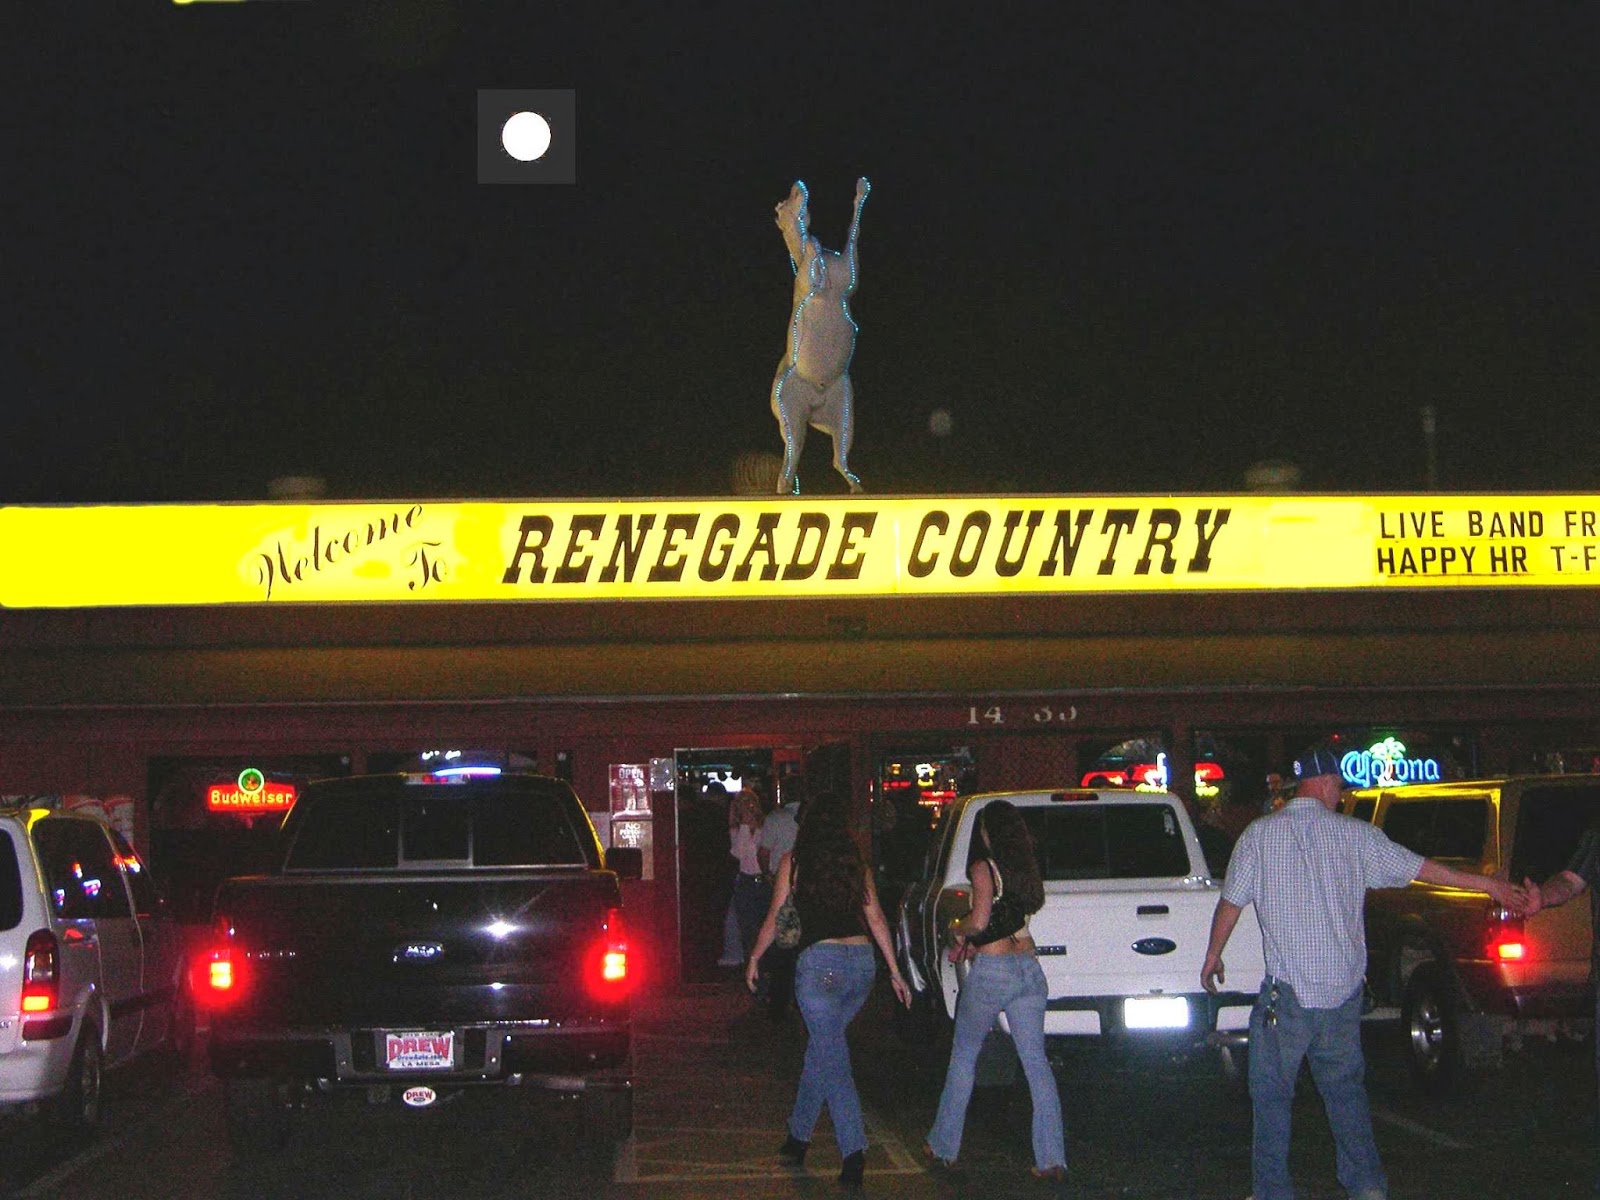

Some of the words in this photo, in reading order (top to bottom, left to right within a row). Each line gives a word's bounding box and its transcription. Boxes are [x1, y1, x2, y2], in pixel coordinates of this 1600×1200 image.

[1380, 510, 1445, 539] LIVE
[1468, 510, 1544, 538] BAND
[1564, 510, 1597, 537] FR
[258, 504, 423, 601] Welcome
[502, 512, 878, 583] RENEGADE
[907, 508, 1231, 577] COUNTRY
[1377, 545, 1476, 575] HAPPY
[1489, 545, 1528, 573] HR
[1550, 545, 1597, 571] T-F
[406, 542, 448, 591] To
[1340, 750, 1440, 788] Corona
[211, 789, 293, 805] Budweiser
[388, 1037, 451, 1062] DREW
[406, 1090, 433, 1100] DREW
